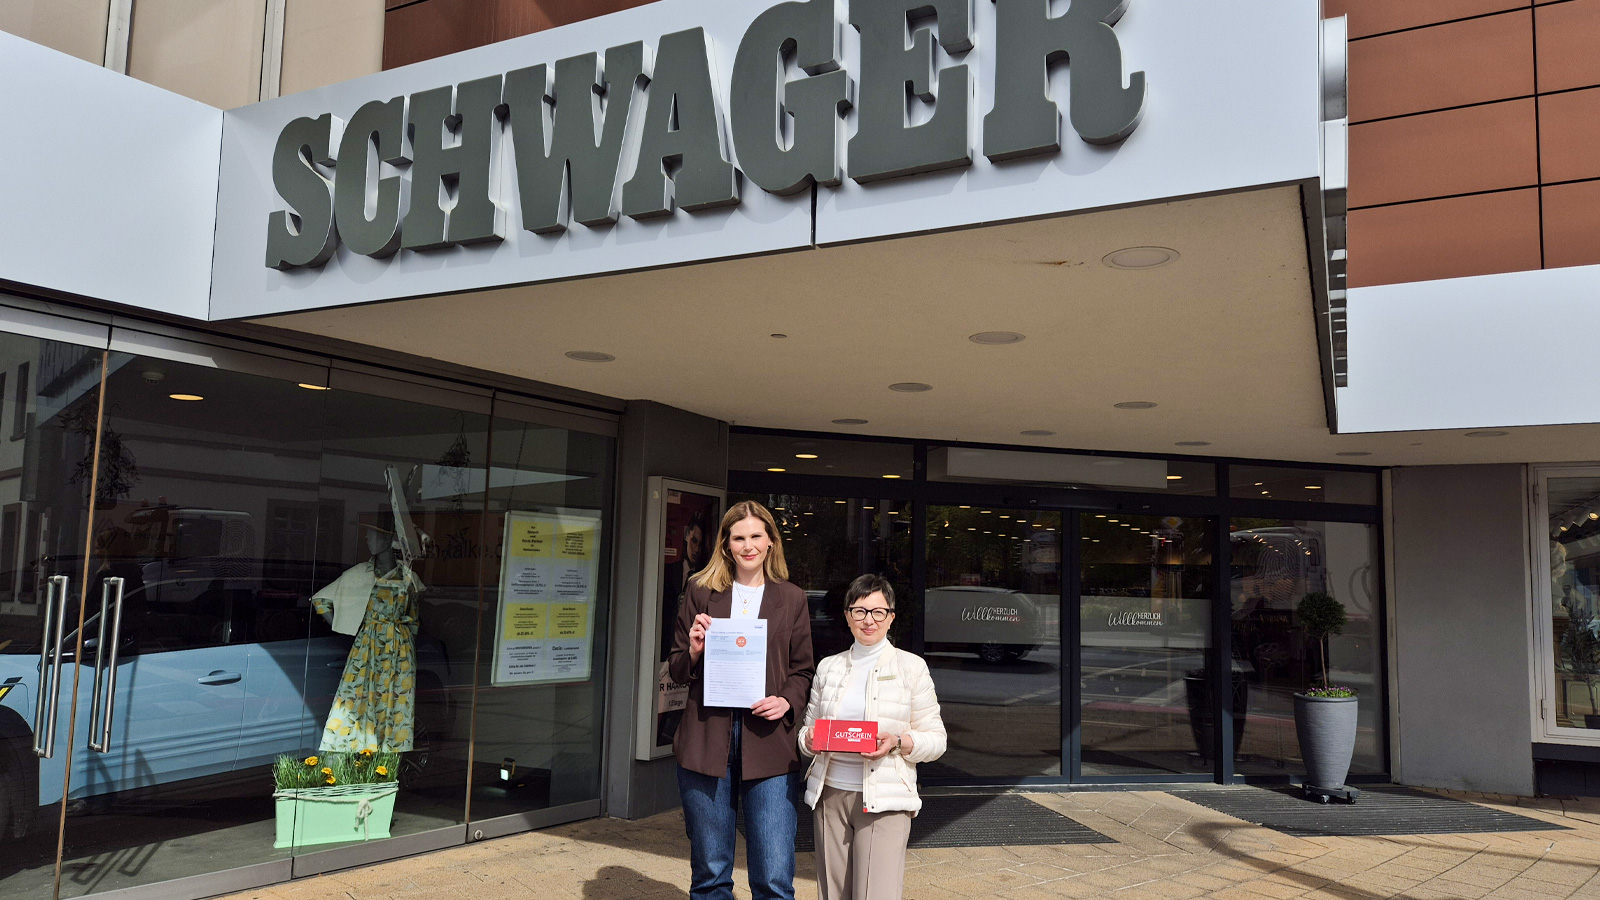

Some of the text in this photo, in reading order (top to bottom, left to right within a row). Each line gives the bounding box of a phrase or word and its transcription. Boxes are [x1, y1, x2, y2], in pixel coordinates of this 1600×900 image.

[264, 0, 1147, 271] SCHWAGER
[961, 605, 1021, 622] Willkommen
[1108, 611, 1164, 626] Willkommen
[1137, 612, 1161, 620] HERZLICH
[834, 731, 872, 739] GUTSCHEIN
